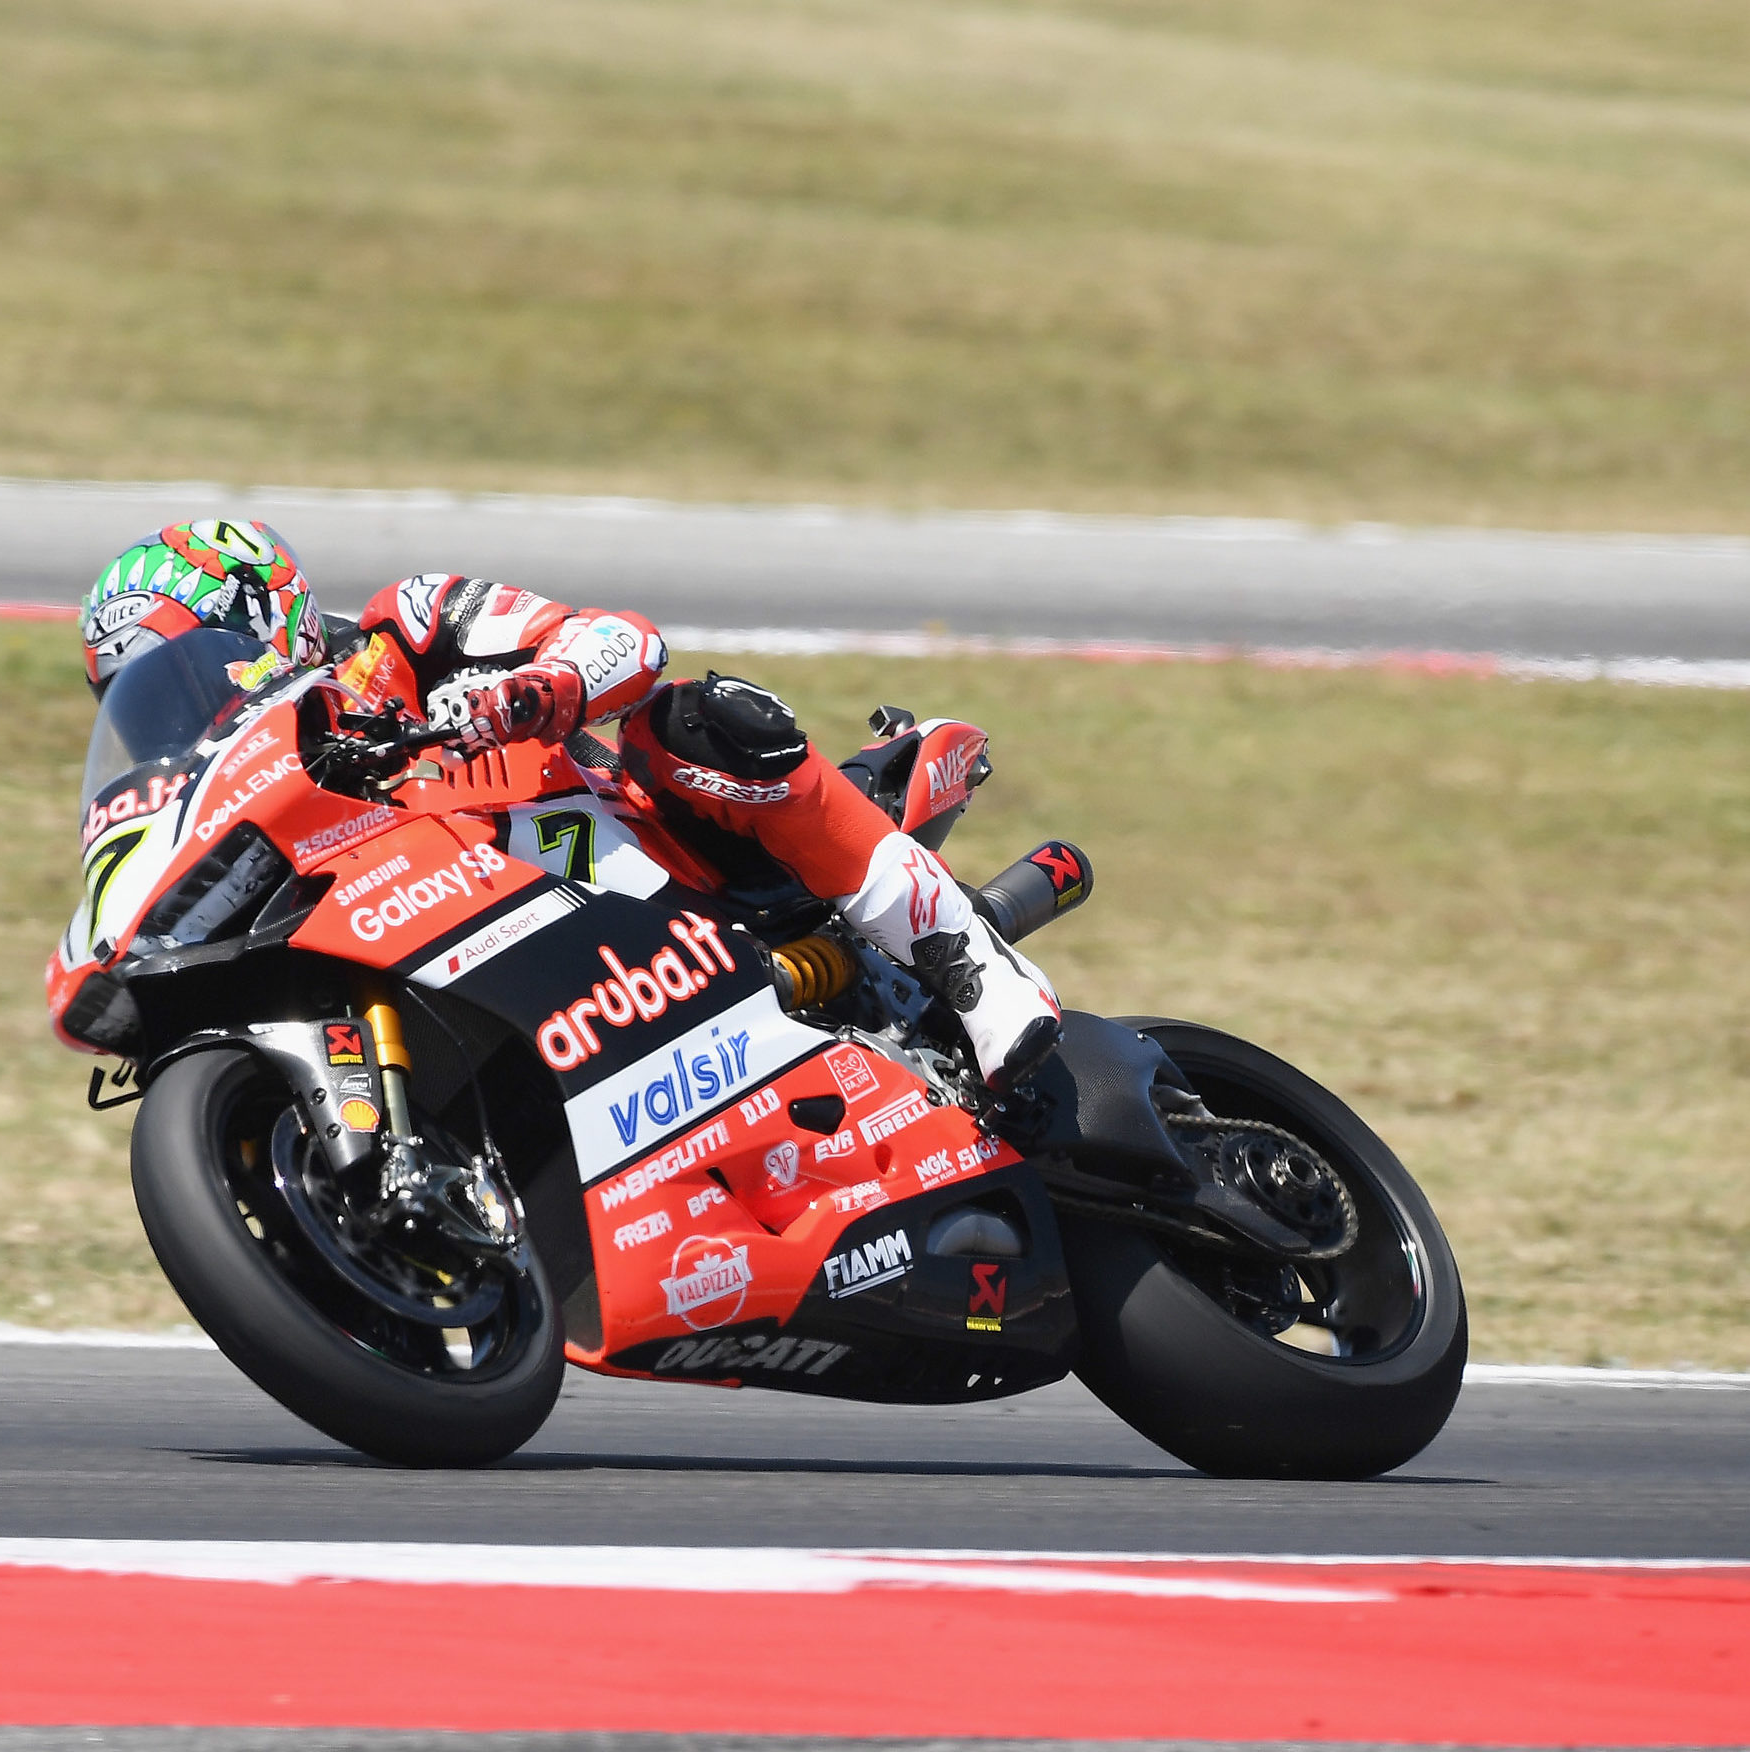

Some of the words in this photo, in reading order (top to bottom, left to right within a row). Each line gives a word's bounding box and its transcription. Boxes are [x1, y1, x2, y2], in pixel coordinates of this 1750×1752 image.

[213, 519, 263, 559] 7
[586, 631, 637, 691] .CLOUD
[925, 743, 967, 800] AVIS
[531, 808, 596, 886] 7
[334, 854, 411, 907] SAMSUNG
[350, 862, 473, 942] Galaxy
[459, 843, 506, 879] S8
[464, 929, 500, 963] Audi
[499, 911, 540, 942] Sport
[537, 909, 737, 1072] aruba.it
[609, 1026, 752, 1148] valsir
[858, 1089, 930, 1146] PIRELLI
[625, 1120, 730, 1200] BAGUTTI
[914, 1148, 953, 1182] NGK
[674, 1264, 742, 1305] VALPIZZA
[823, 1229, 912, 1292] FIAMM
[654, 1334, 851, 1376] DUCATI
